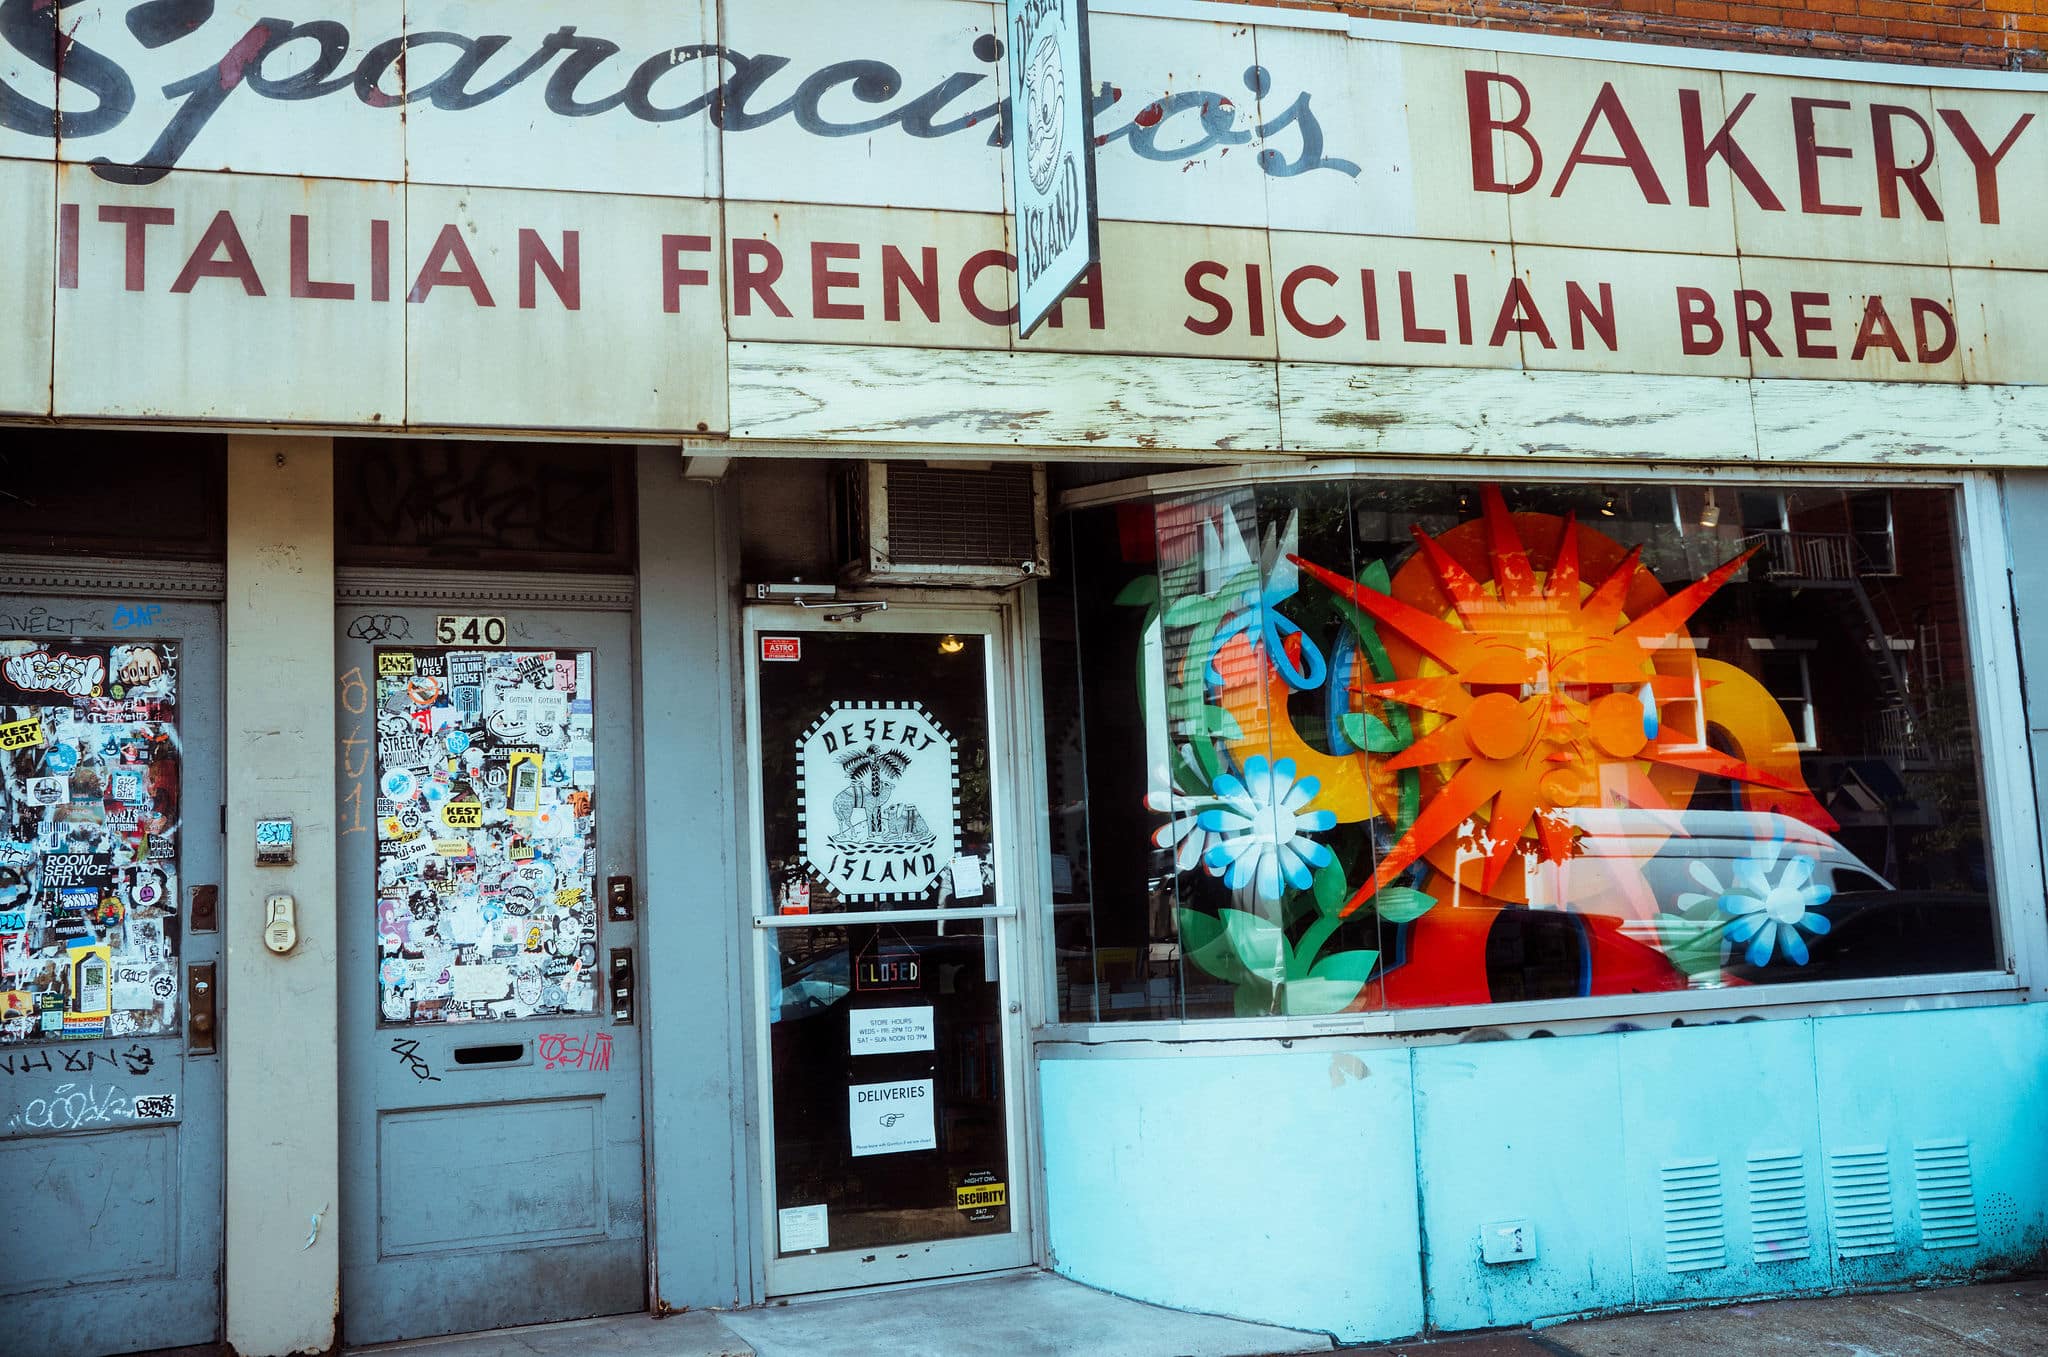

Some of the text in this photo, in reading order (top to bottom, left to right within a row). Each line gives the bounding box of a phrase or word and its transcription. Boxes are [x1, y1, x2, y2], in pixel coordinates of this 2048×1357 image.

[0, 0, 1361, 186] Sparacio's
[1465, 69, 2034, 226] BAKERY
[1023, 150, 1078, 293] ISLAND
[60, 203, 581, 311] ITALIAN
[1184, 260, 1617, 352] SICILIAN
[1678, 287, 1957, 365] BREAD
[438, 617, 505, 645] 540
[770, 644, 794, 652] ASTRO
[416, 656, 445, 668] VAULT
[118, 666, 158, 680] COMA
[509, 696, 562, 705] GOTHAM GOTHAM
[3, 732, 36, 747] GAK
[822, 718, 937, 753] DESERT
[383, 735, 416, 752] STREET
[385, 750, 420, 767] BRILLIANCE
[446, 807, 480, 815] KEST
[448, 815, 475, 824] GAK
[46, 854, 94, 866] ROOM
[828, 853, 936, 883] ISLAND
[509, 903, 526, 915] CLUB
[860, 962, 918, 982] CLOSED
[871, 1018, 913, 1027] STORE HOURS
[859, 1028, 876, 1036] WEDS
[889, 1035, 906, 1043] NOON
[916, 1033, 928, 1041] 7PM
[858, 1085, 925, 1103] DELIVERIES
[964, 1176, 983, 1184] NIGHT
[958, 1190, 1004, 1206] SECURITY
